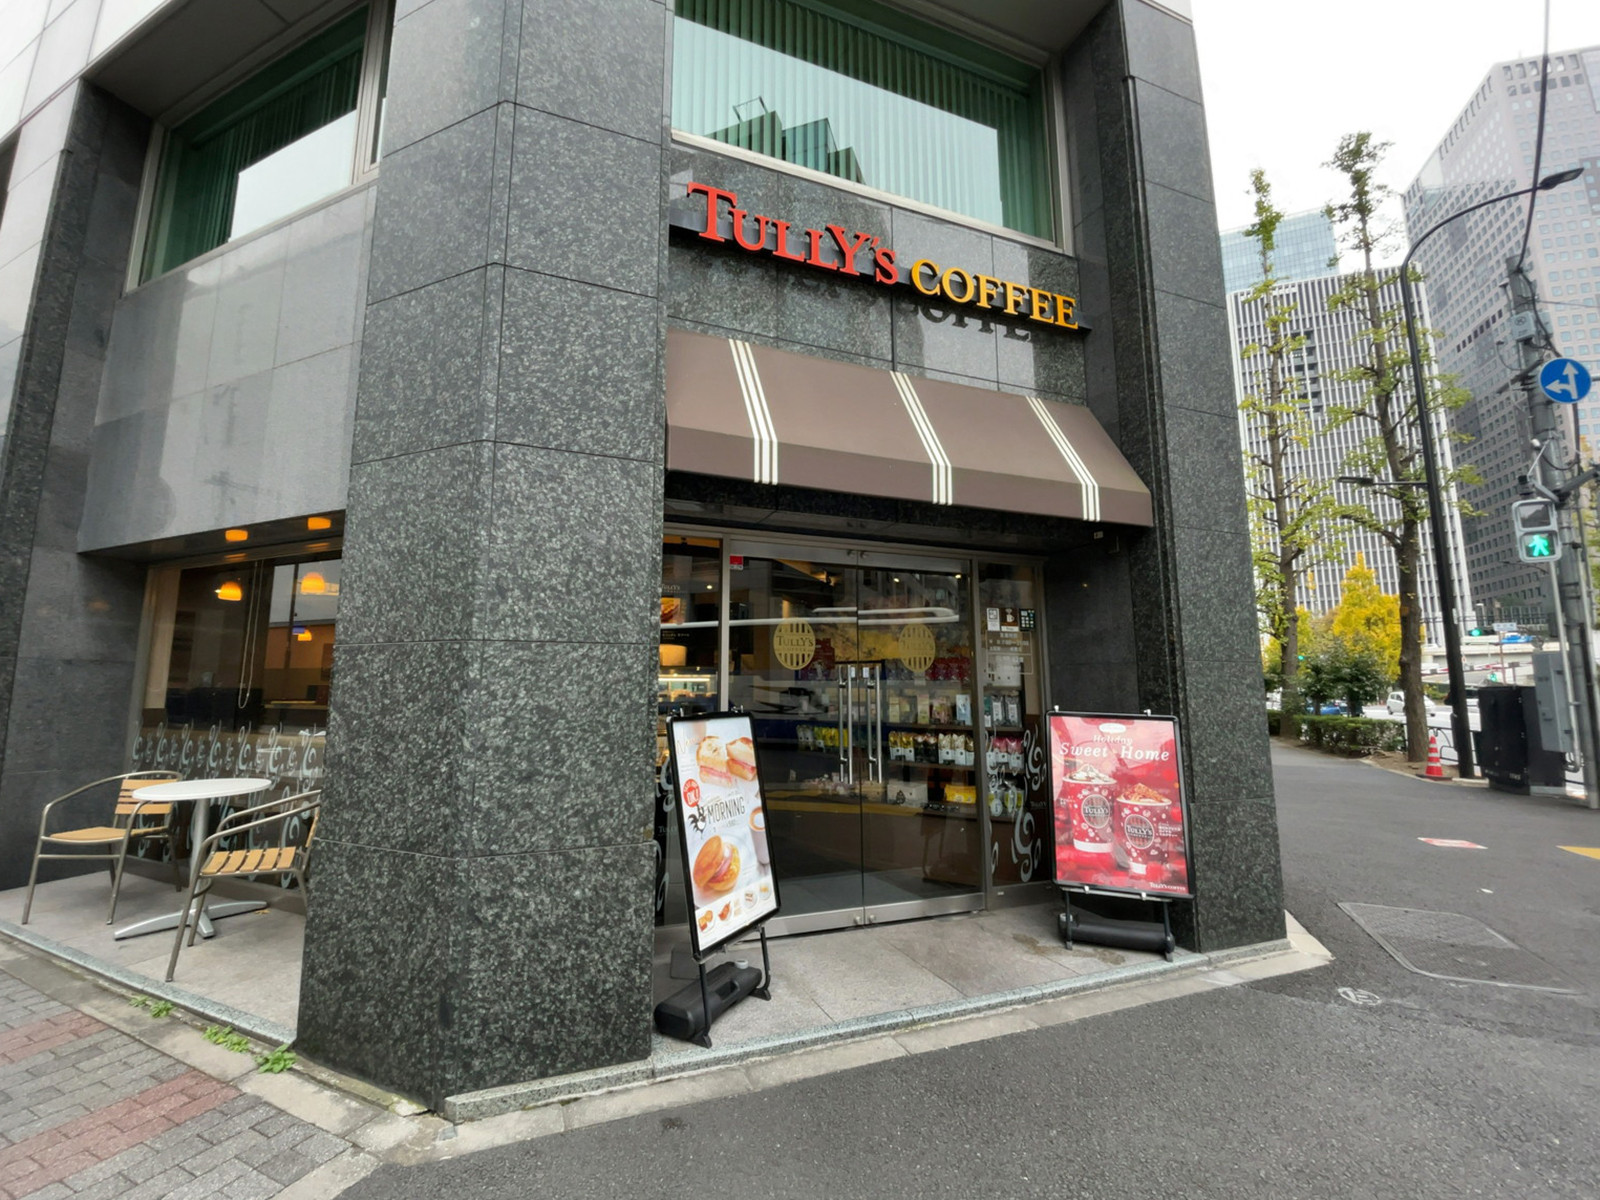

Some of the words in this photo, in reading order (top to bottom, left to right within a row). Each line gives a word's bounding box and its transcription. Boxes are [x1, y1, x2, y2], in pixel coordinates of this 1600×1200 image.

[687, 181, 900, 285] TULLY'S
[911, 259, 1079, 330] COFFEE
[776, 635, 814, 647] TULLY'S
[1093, 734, 1133, 746] Holiday
[1060, 742, 1108, 757] Sweet
[1121, 745, 1170, 761] Home
[707, 796, 746, 825] MORNING
[1126, 824, 1153, 836] TULLY'S
